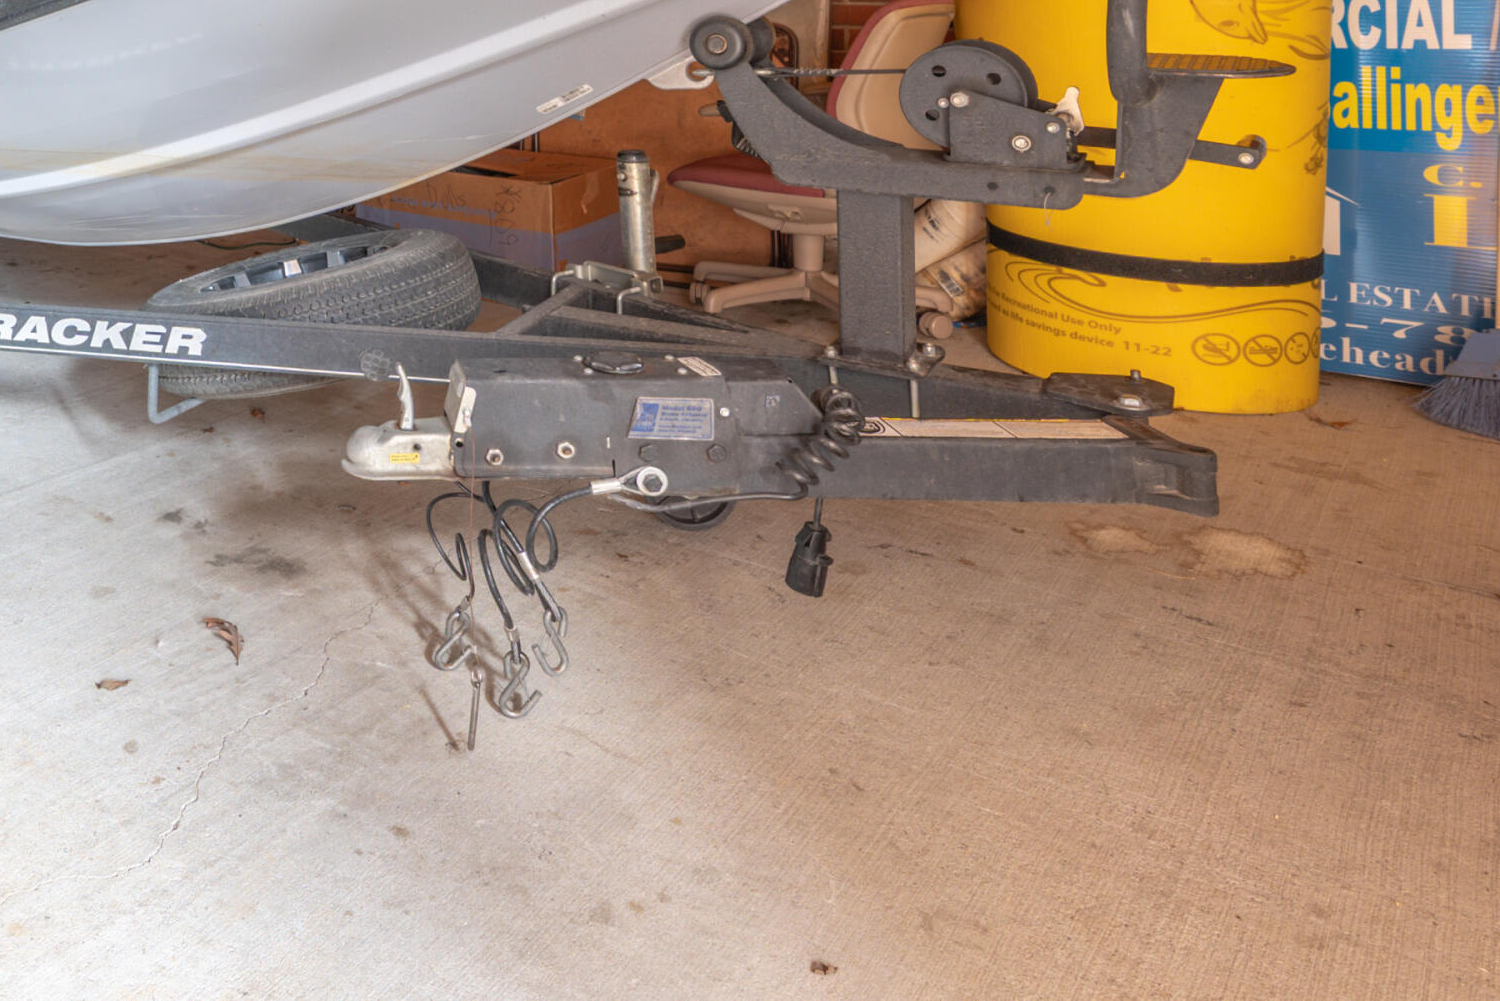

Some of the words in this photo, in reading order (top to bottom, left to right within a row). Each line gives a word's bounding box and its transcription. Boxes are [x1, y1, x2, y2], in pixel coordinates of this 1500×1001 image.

[1333, 65, 1500, 151] allinge
[1025, 318, 1067, 337] savings
[1069, 330, 1115, 348] device
[1123, 340, 1173, 357] 11-22
[1061, 313, 1085, 327] Use
[1088, 319, 1122, 336] Only
